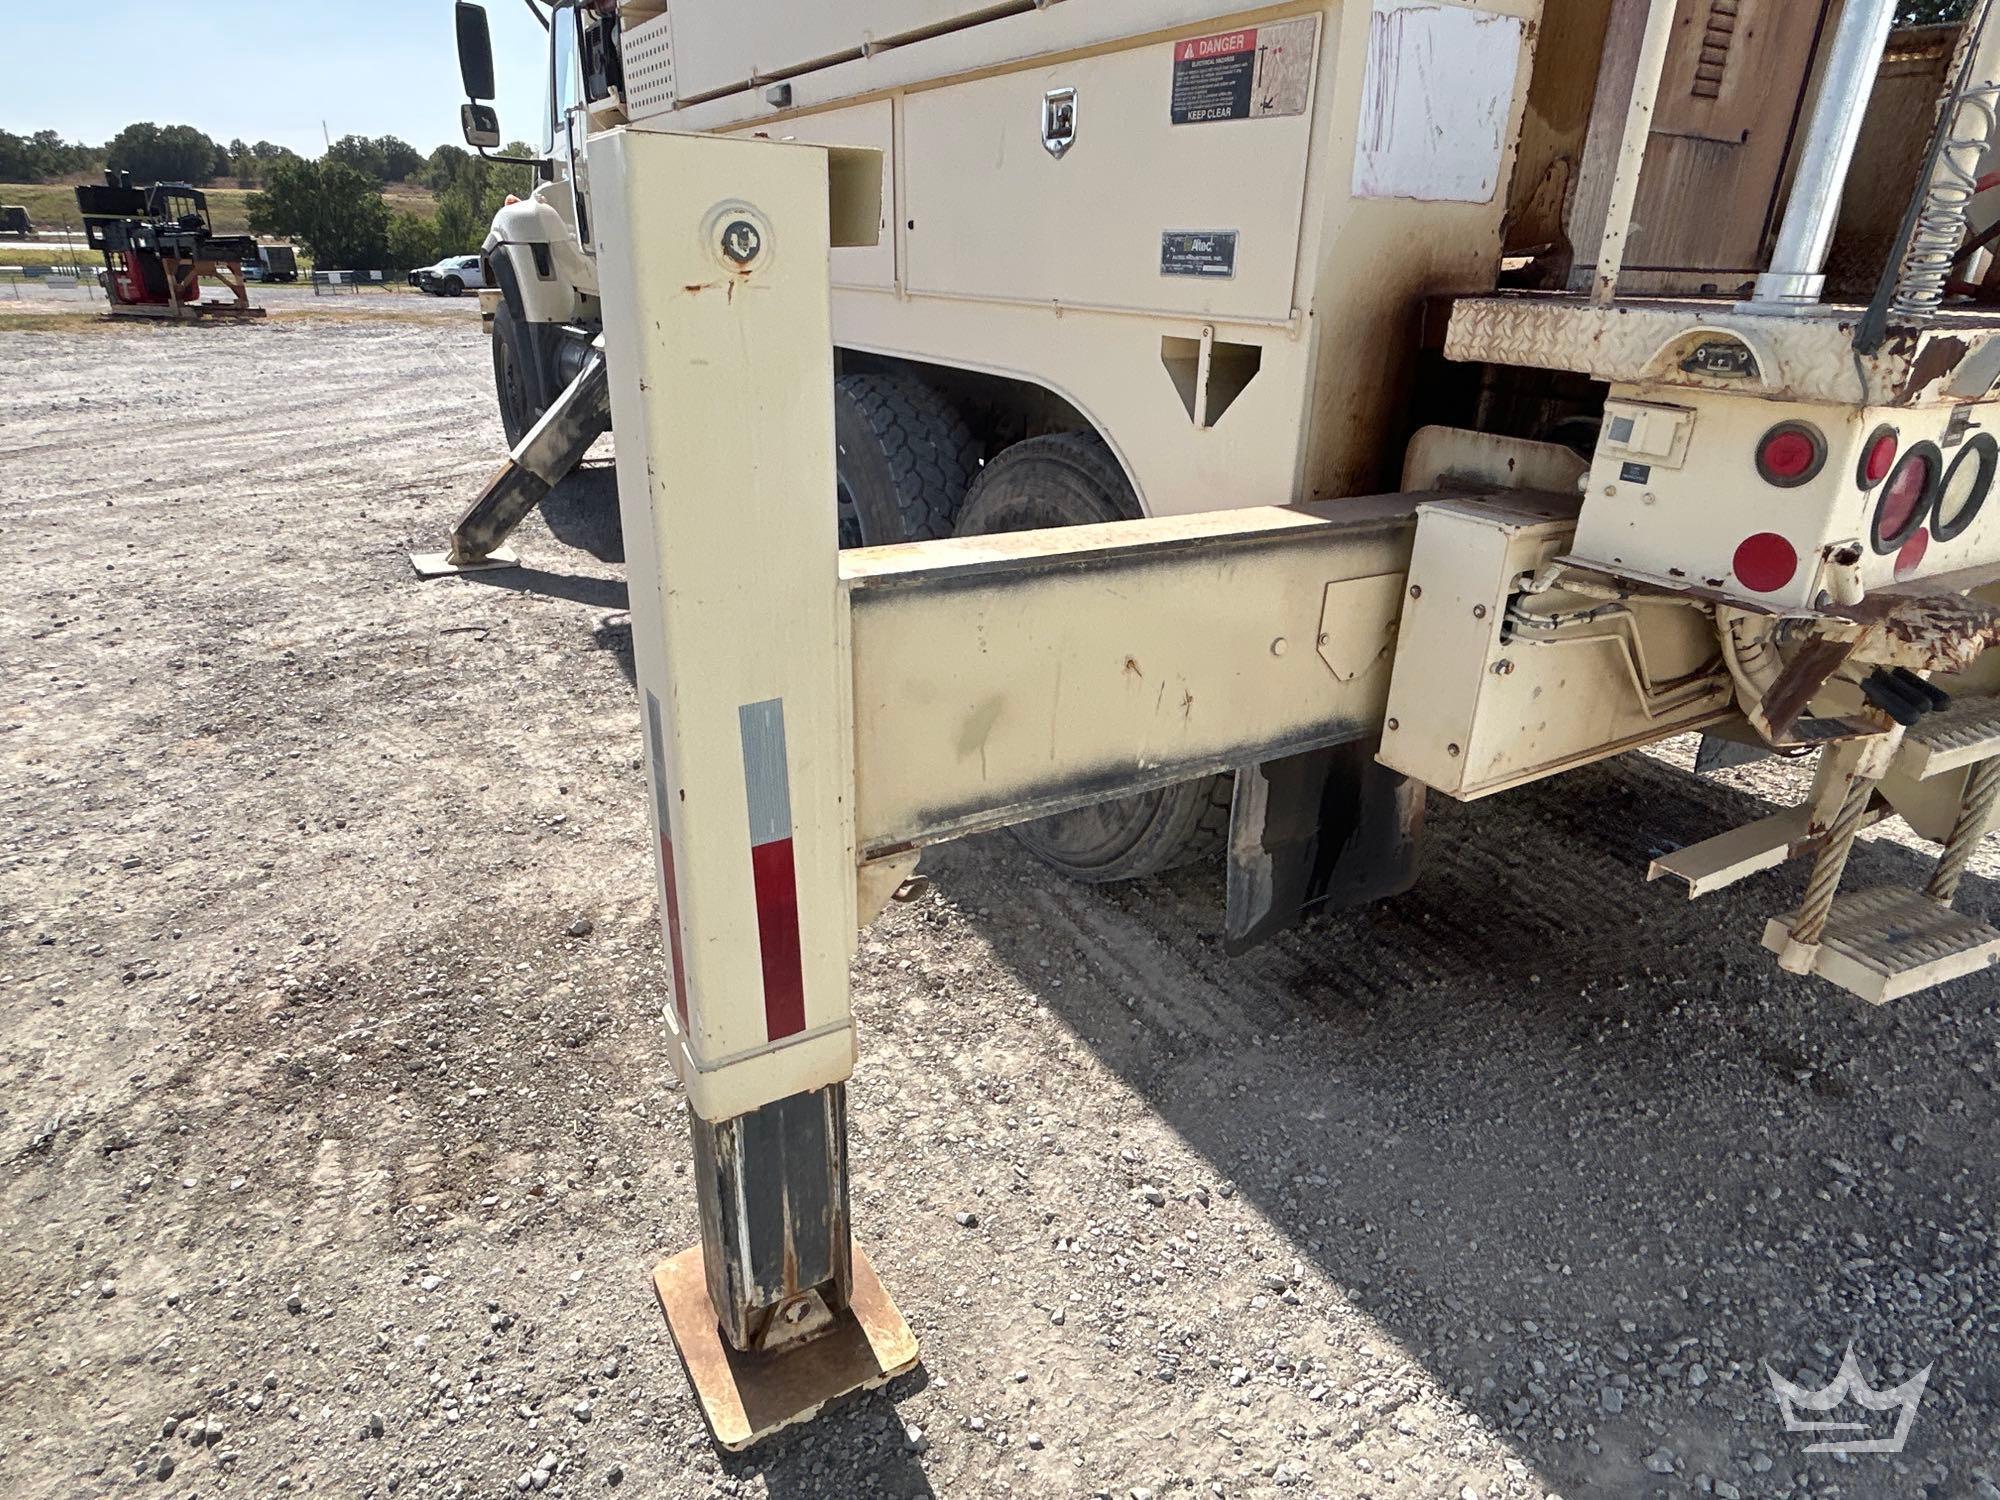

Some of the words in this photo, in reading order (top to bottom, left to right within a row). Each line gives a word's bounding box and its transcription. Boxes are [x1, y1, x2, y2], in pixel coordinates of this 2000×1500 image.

[1200, 34, 1244, 55] DANGER
[1188, 110, 1206, 120] KEEP
[1207, 107, 1231, 119] CLEAR
